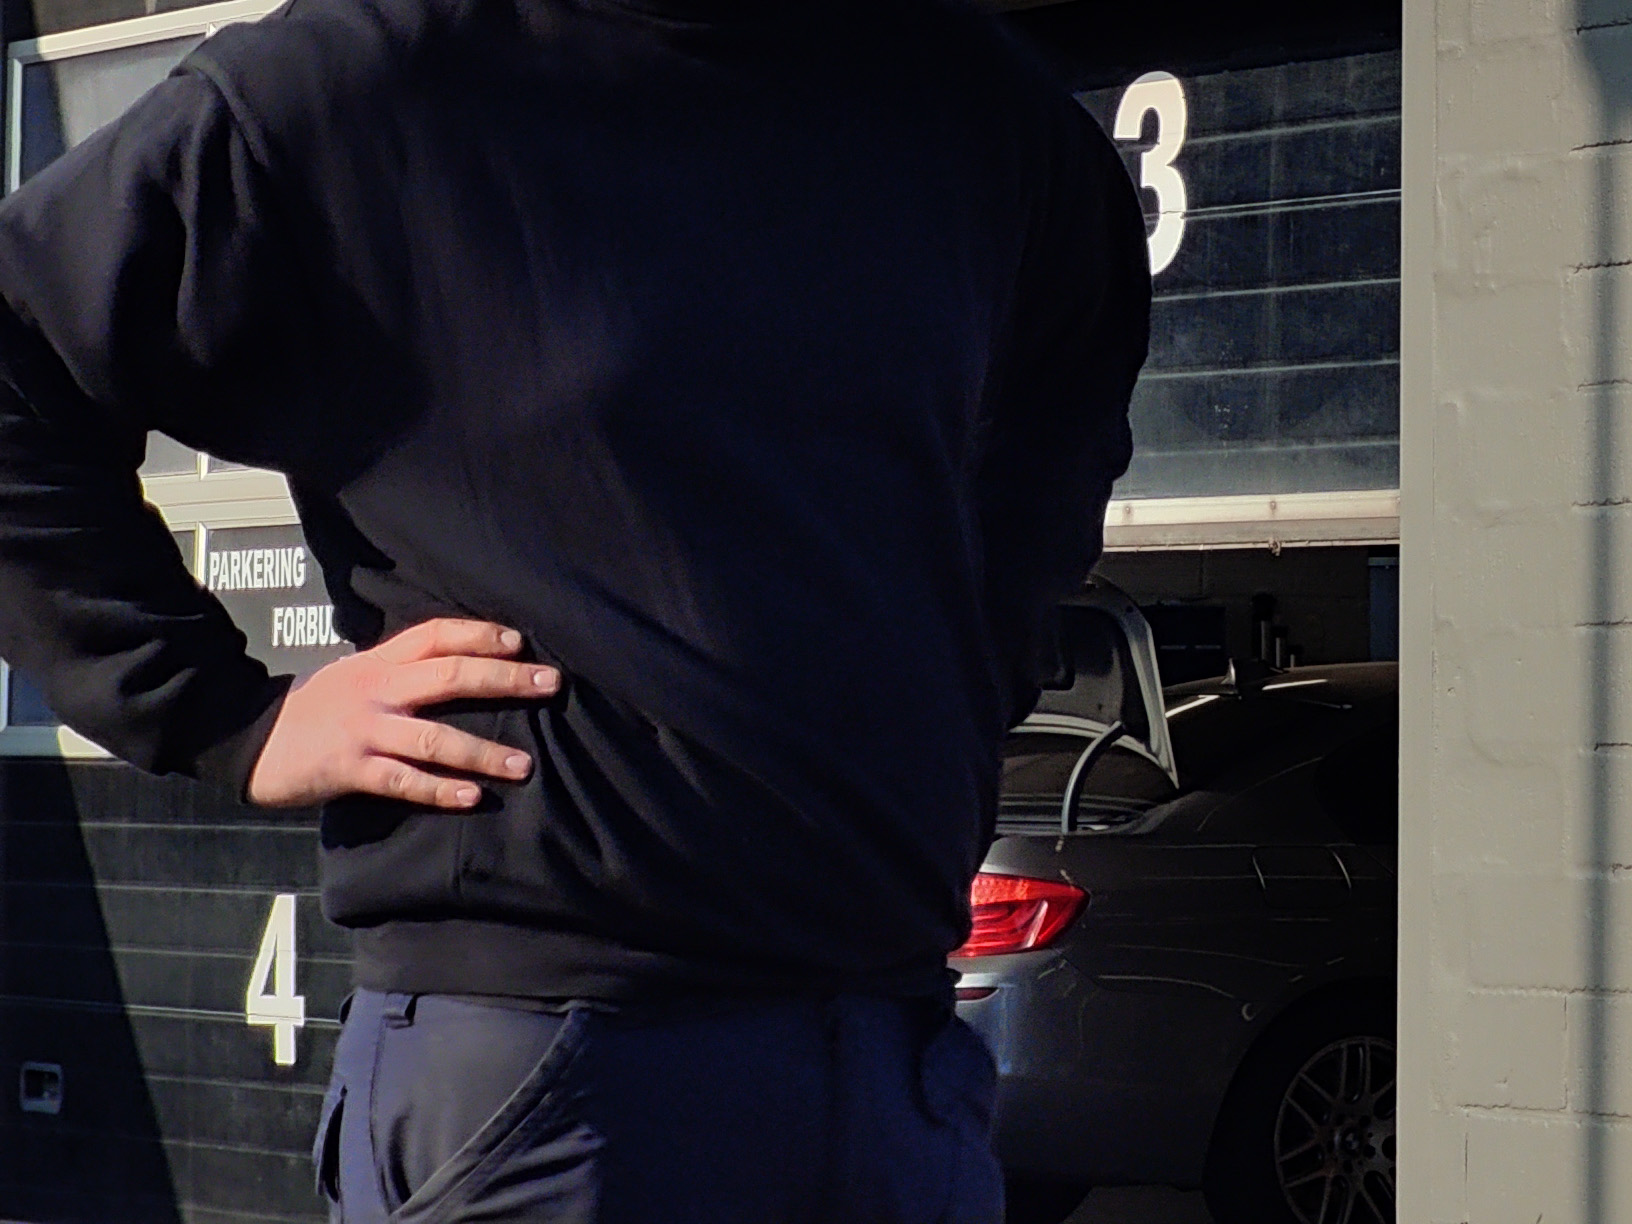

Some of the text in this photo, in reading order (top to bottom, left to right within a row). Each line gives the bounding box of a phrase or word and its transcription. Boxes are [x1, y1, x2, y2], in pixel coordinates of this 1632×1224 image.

[1113, 71, 1187, 276] 3
[208, 547, 307, 591] PARKERING
[246, 893, 306, 1066] 4
